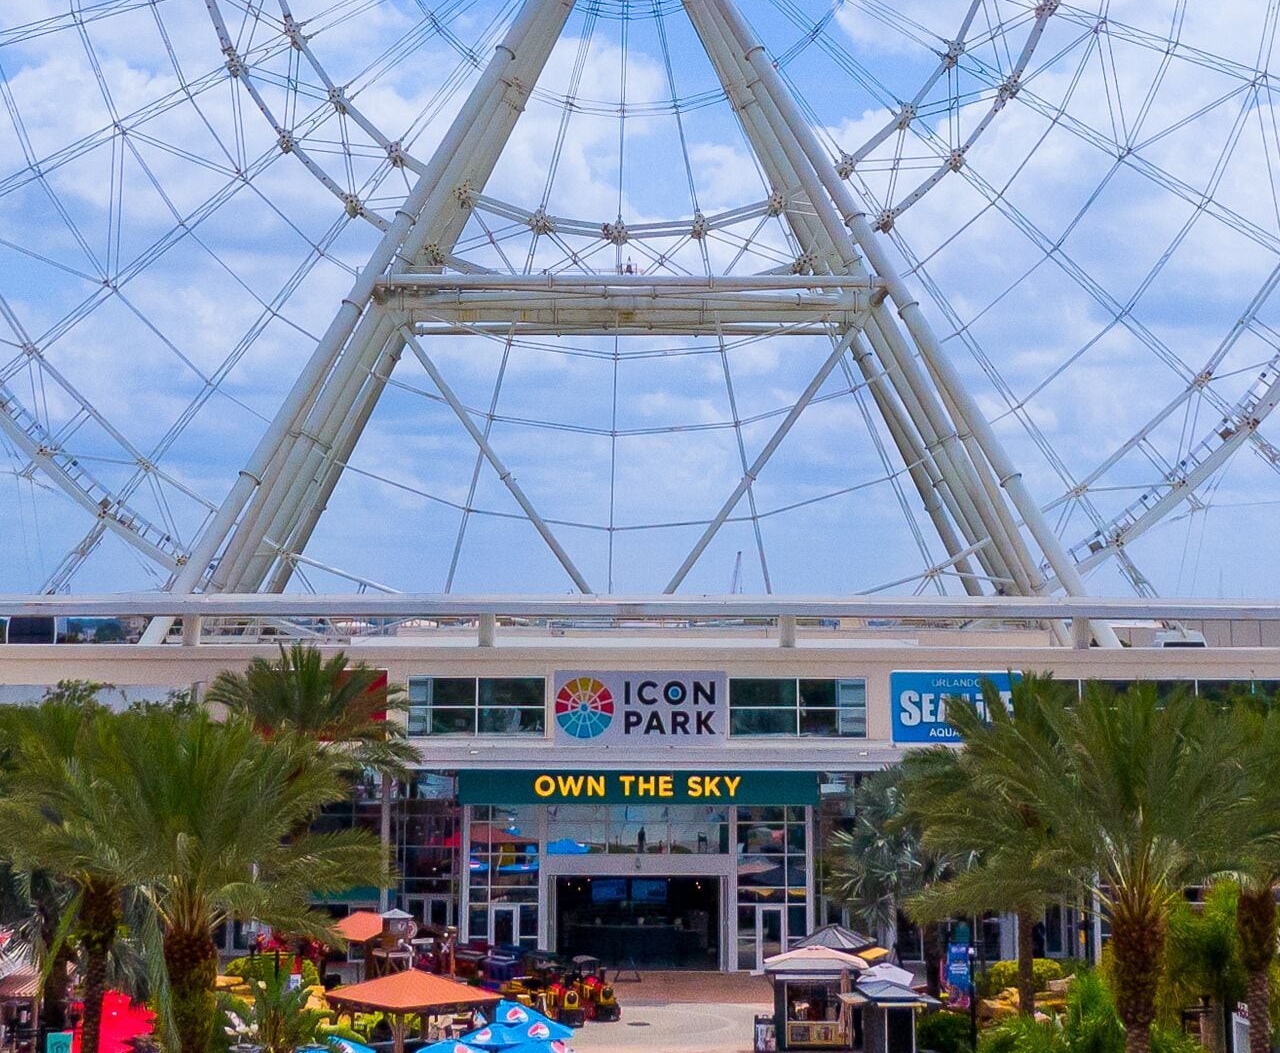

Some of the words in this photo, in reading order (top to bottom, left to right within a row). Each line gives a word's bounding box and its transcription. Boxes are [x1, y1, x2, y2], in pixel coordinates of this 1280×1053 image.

[624, 680, 716, 705] ICON
[931, 678, 982, 687] ORLANDO
[624, 710, 716, 735] PARK
[929, 728, 961, 738] AQUA
[534, 774, 606, 797] OWN
[619, 774, 674, 797] THE
[687, 775, 741, 797] SKY
